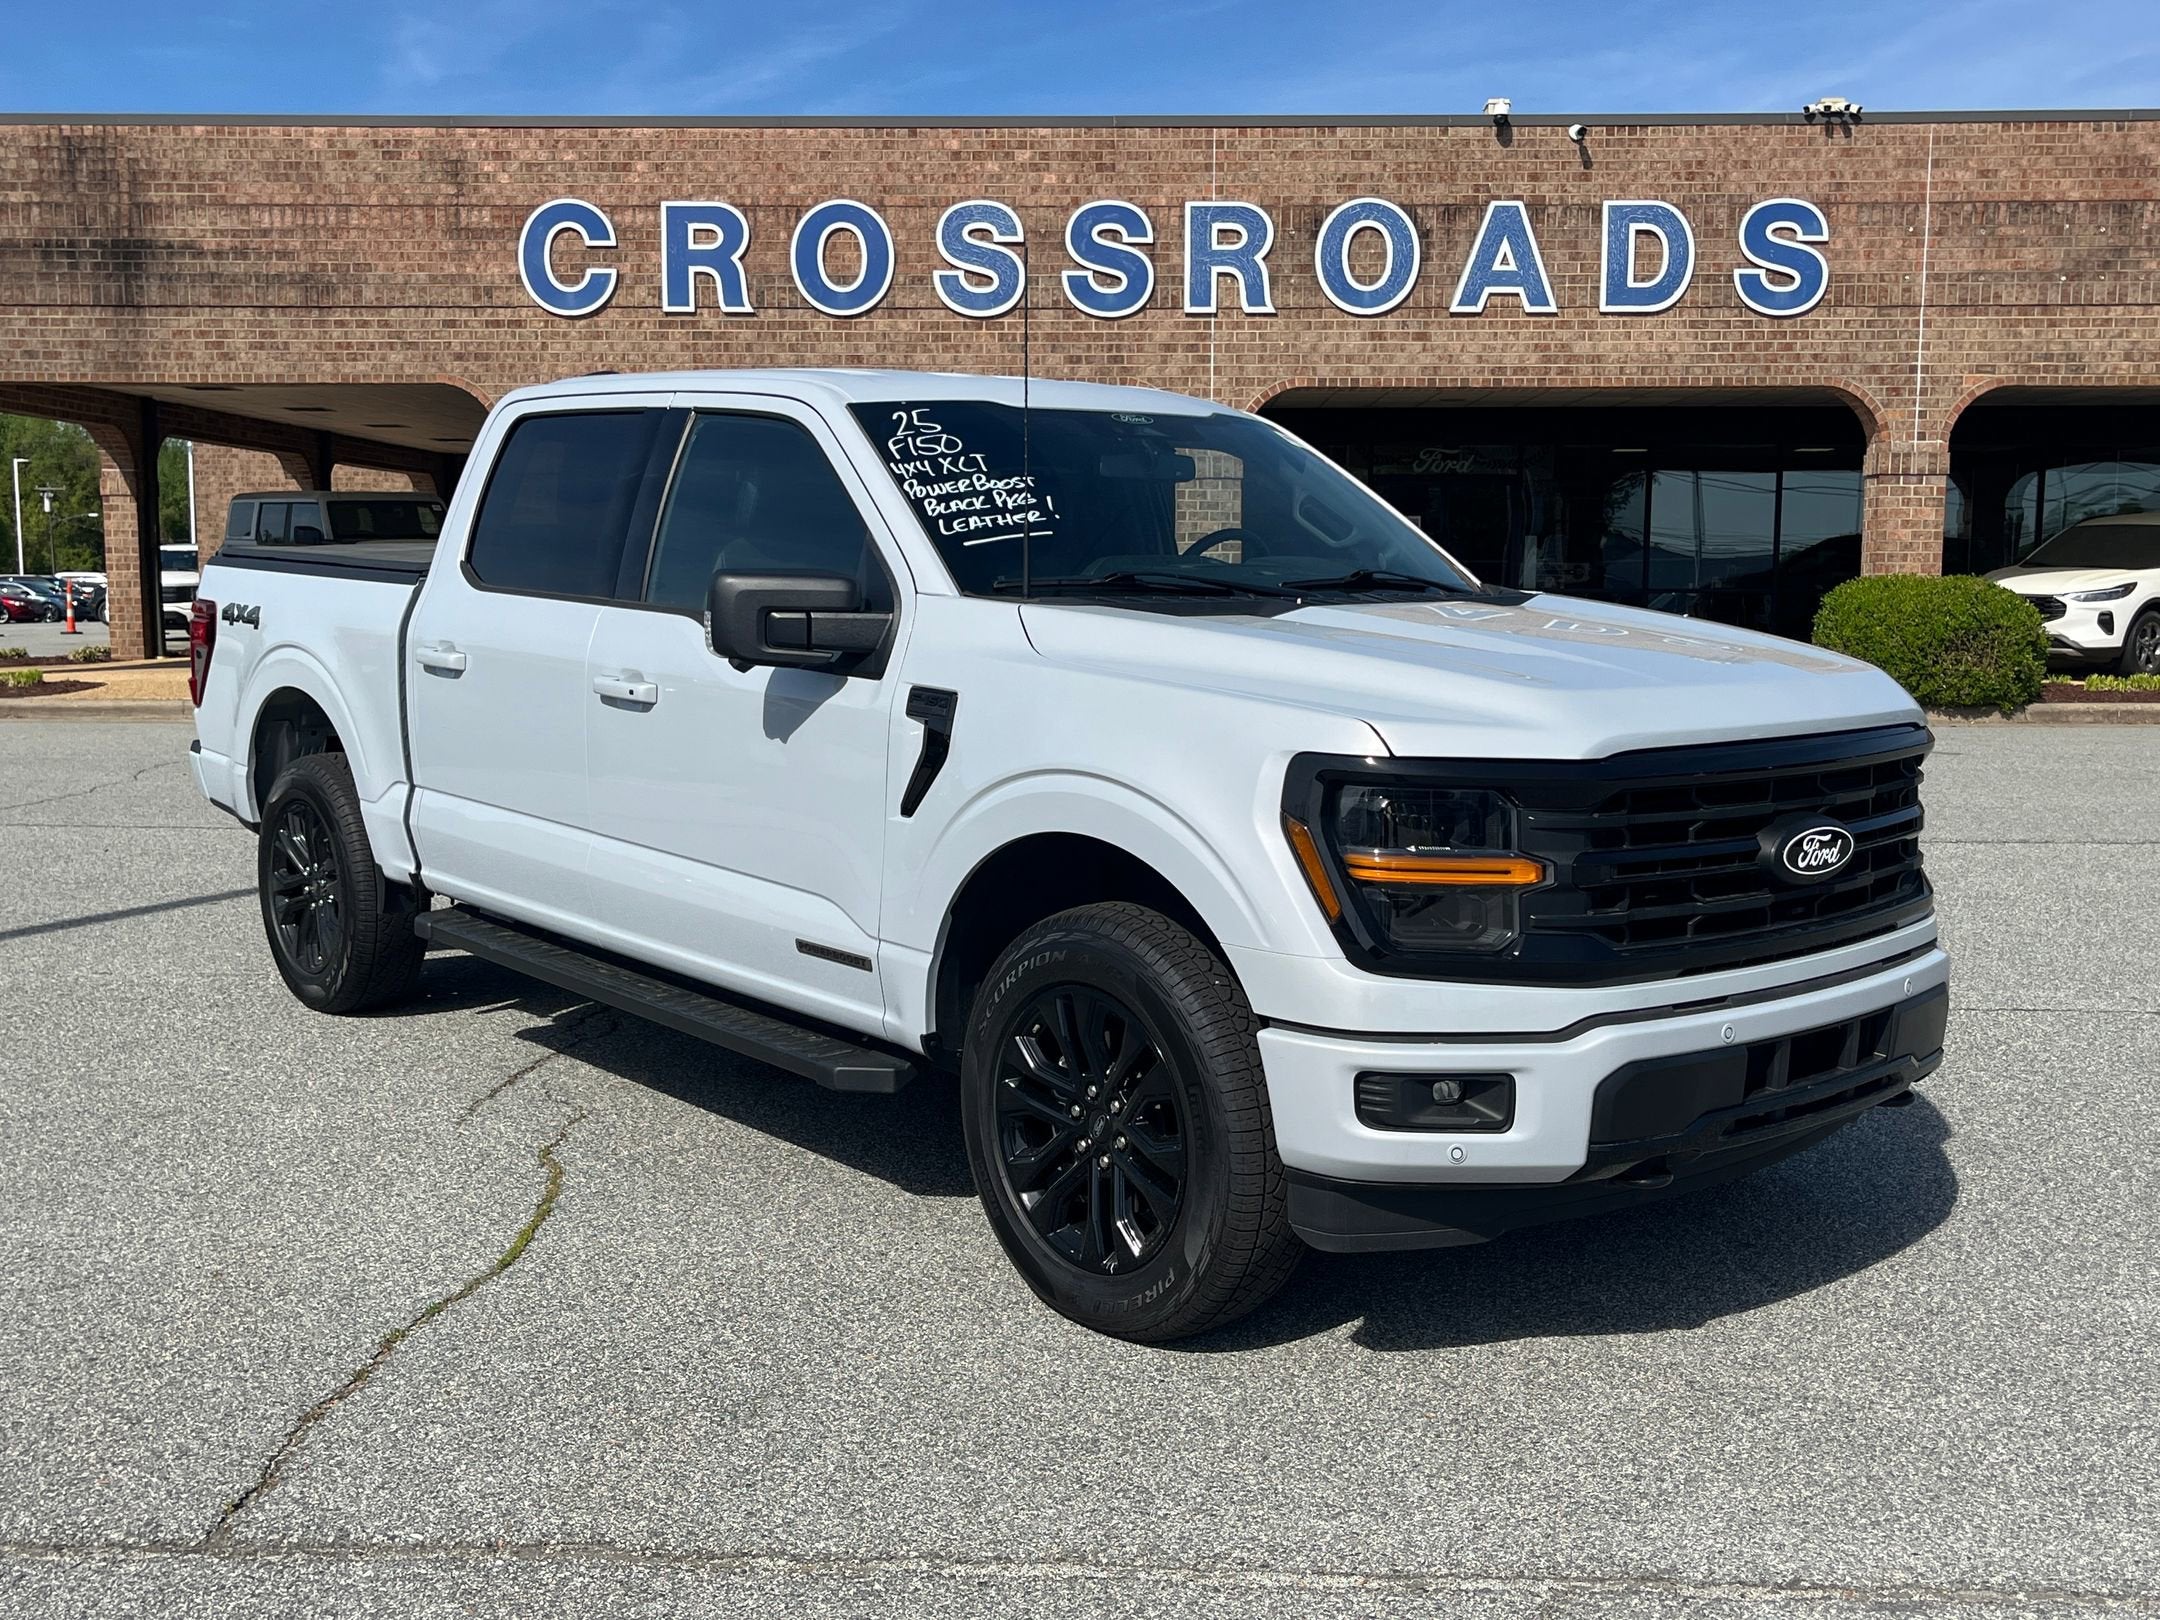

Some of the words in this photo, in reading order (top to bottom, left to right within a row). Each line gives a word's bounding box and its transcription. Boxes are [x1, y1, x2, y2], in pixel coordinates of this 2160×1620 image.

[517, 198, 1830, 318] CROSSROADS
[892, 408, 942, 436] 25
[888, 433, 963, 460] F150
[1413, 447, 1475, 473] Ford
[924, 496, 991, 517] BLACK
[1796, 832, 1843, 869] Ford
[978, 949, 1068, 1038] SCORPION
